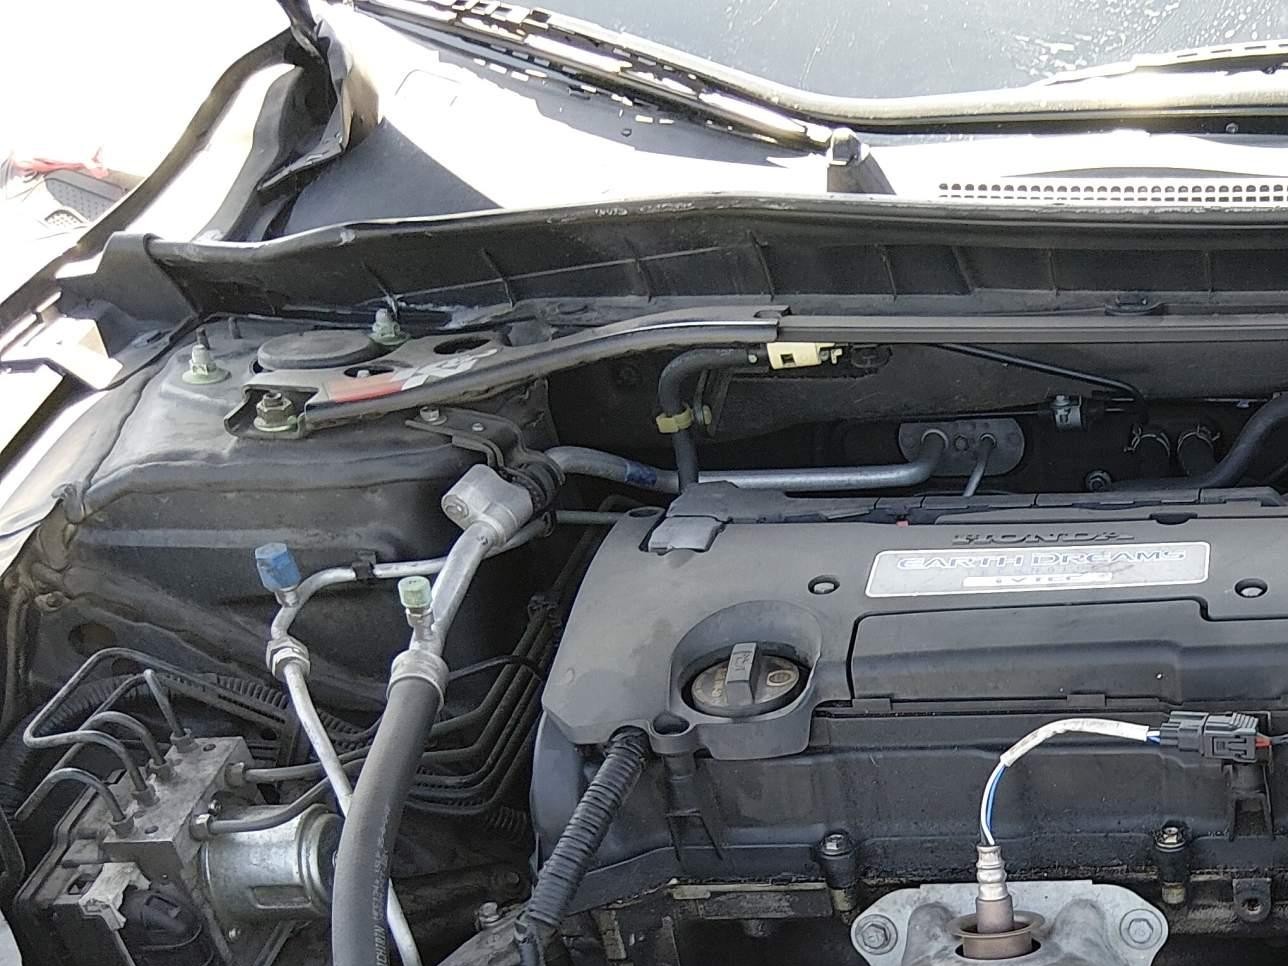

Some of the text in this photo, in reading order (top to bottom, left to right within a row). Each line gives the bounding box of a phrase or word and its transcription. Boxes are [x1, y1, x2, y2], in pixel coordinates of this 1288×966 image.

[952, 532, 1135, 546] HONDA
[897, 550, 1187, 570] EARTH DREAMS
